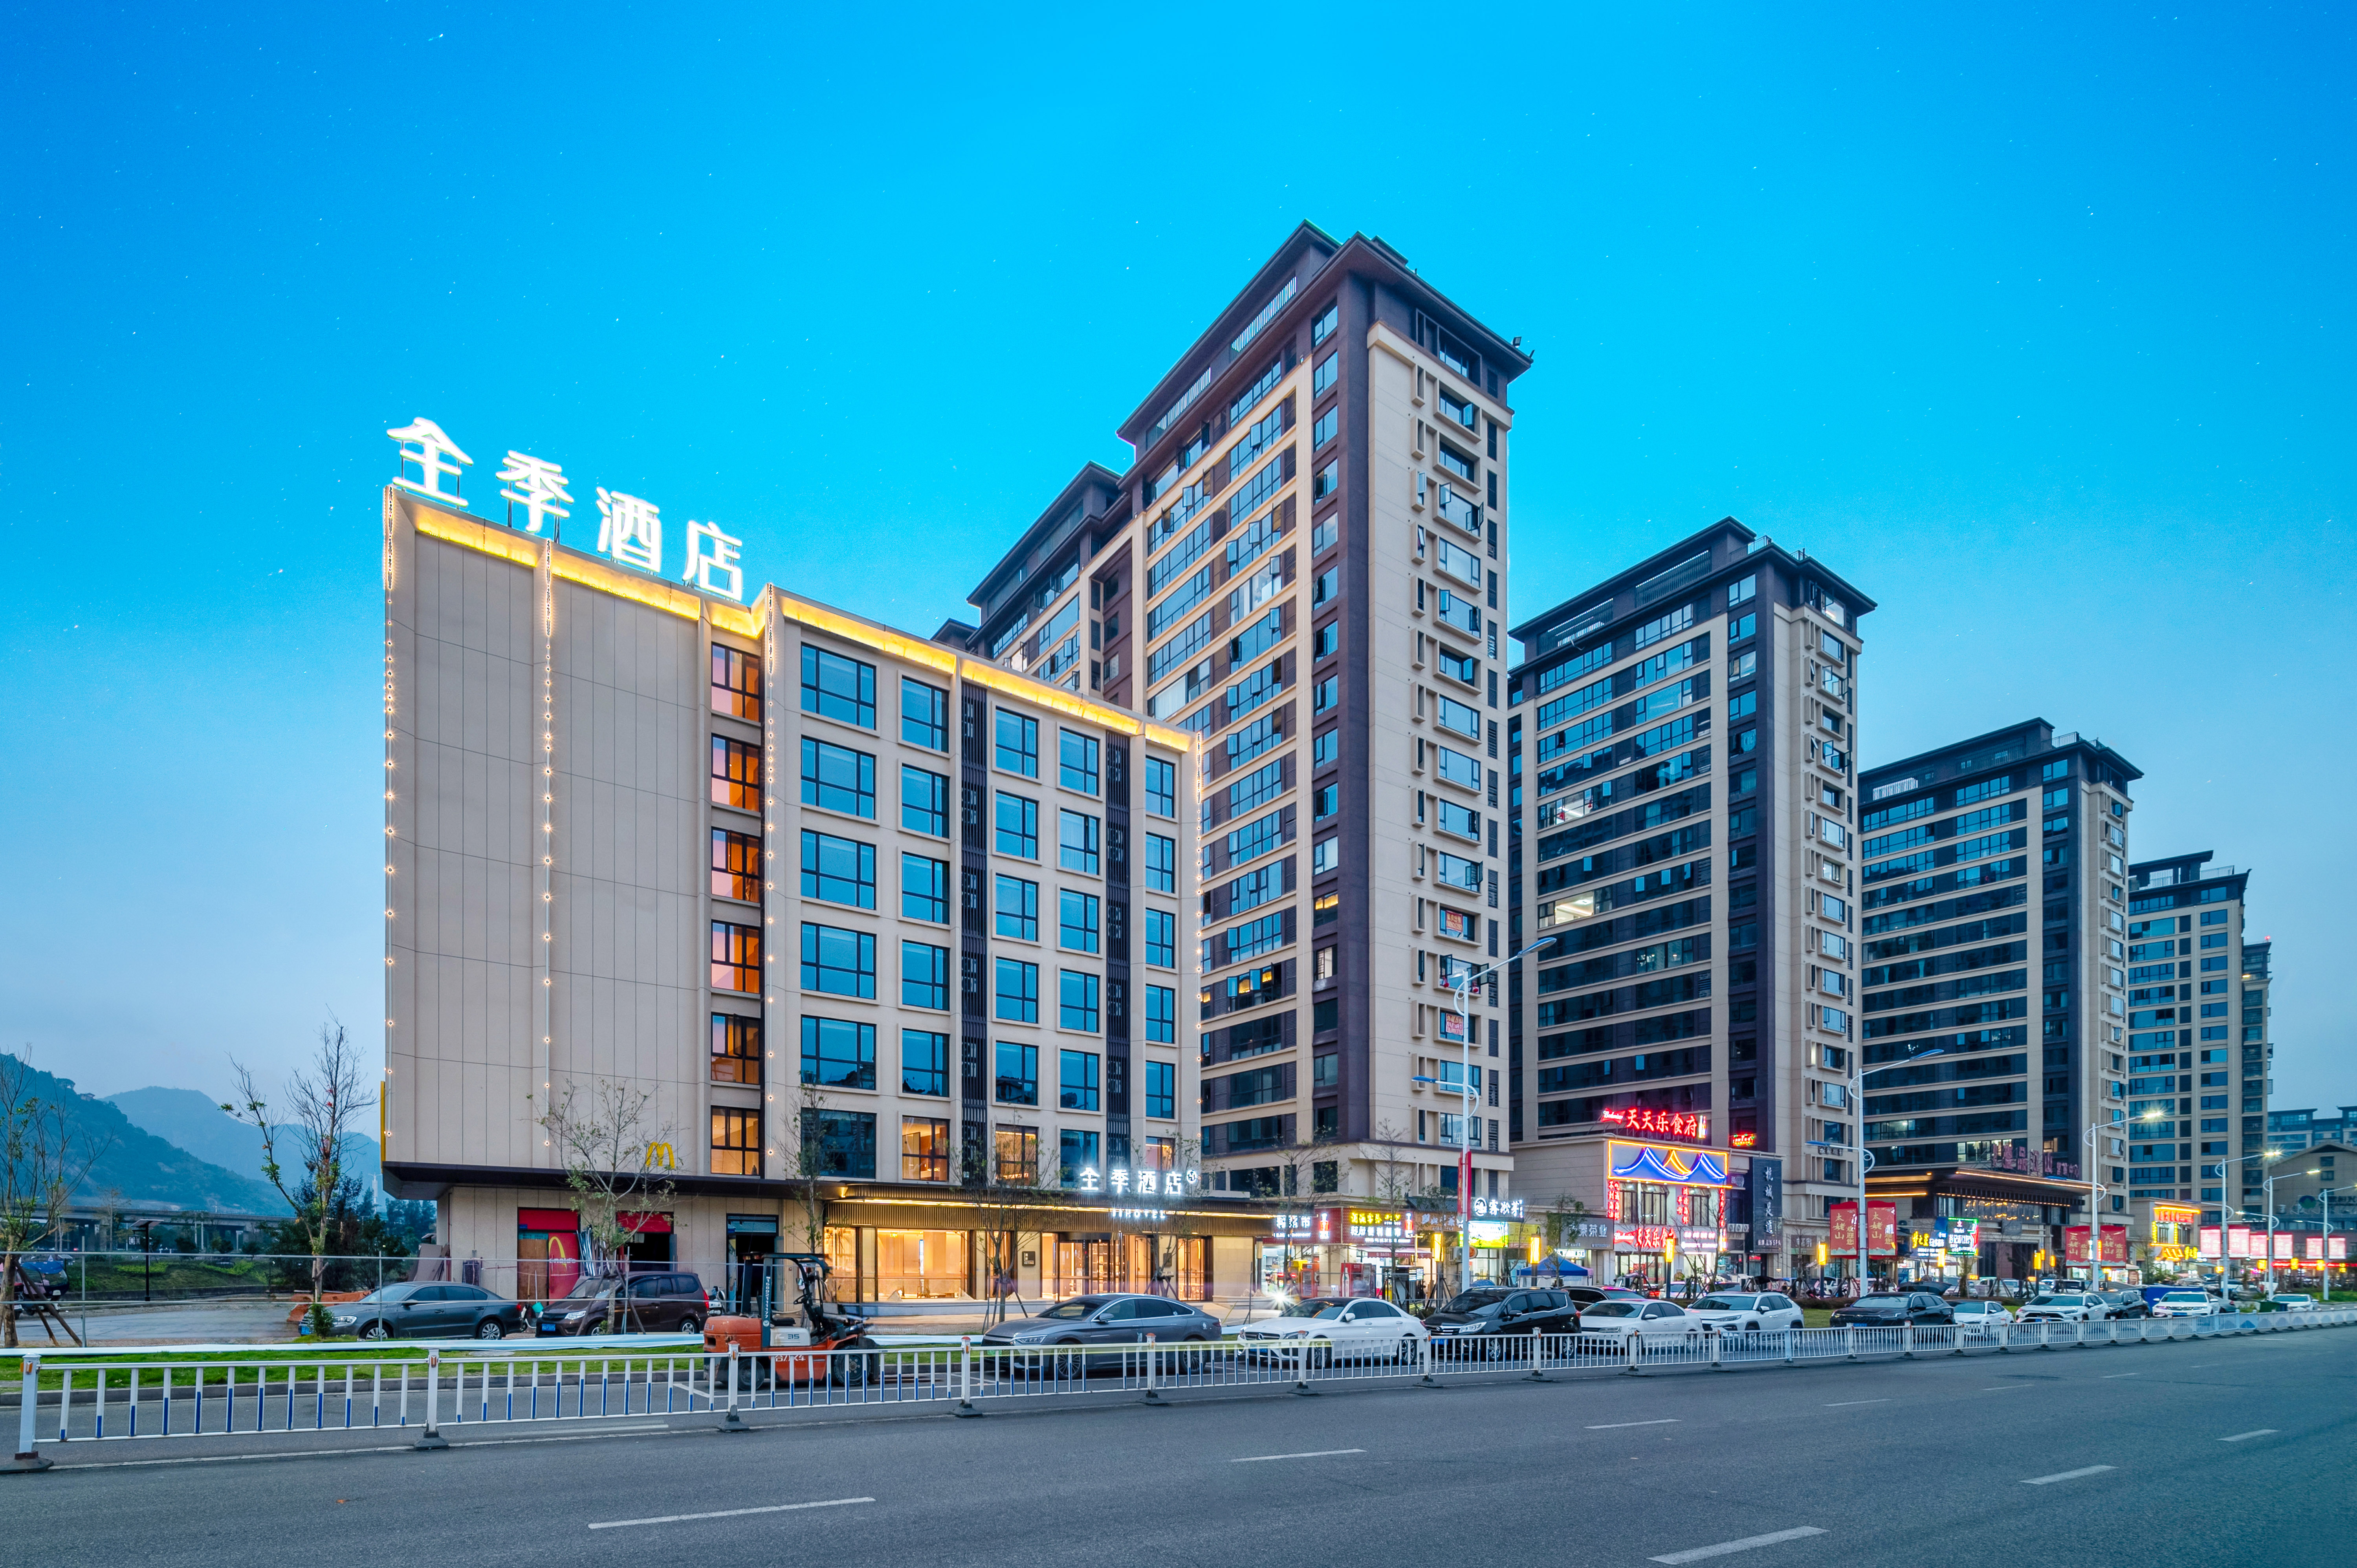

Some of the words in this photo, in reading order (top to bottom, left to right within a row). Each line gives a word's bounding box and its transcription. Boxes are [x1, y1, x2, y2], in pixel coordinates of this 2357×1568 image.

[387, 417, 743, 601] 全季酒店
[1626, 1108, 1697, 1137] 天天乐食府
[1080, 1167, 1182, 1194] 全季酒店
[1832, 1213, 1846, 1240] 太姥山
[1869, 1211, 1883, 1239] 太姥山
